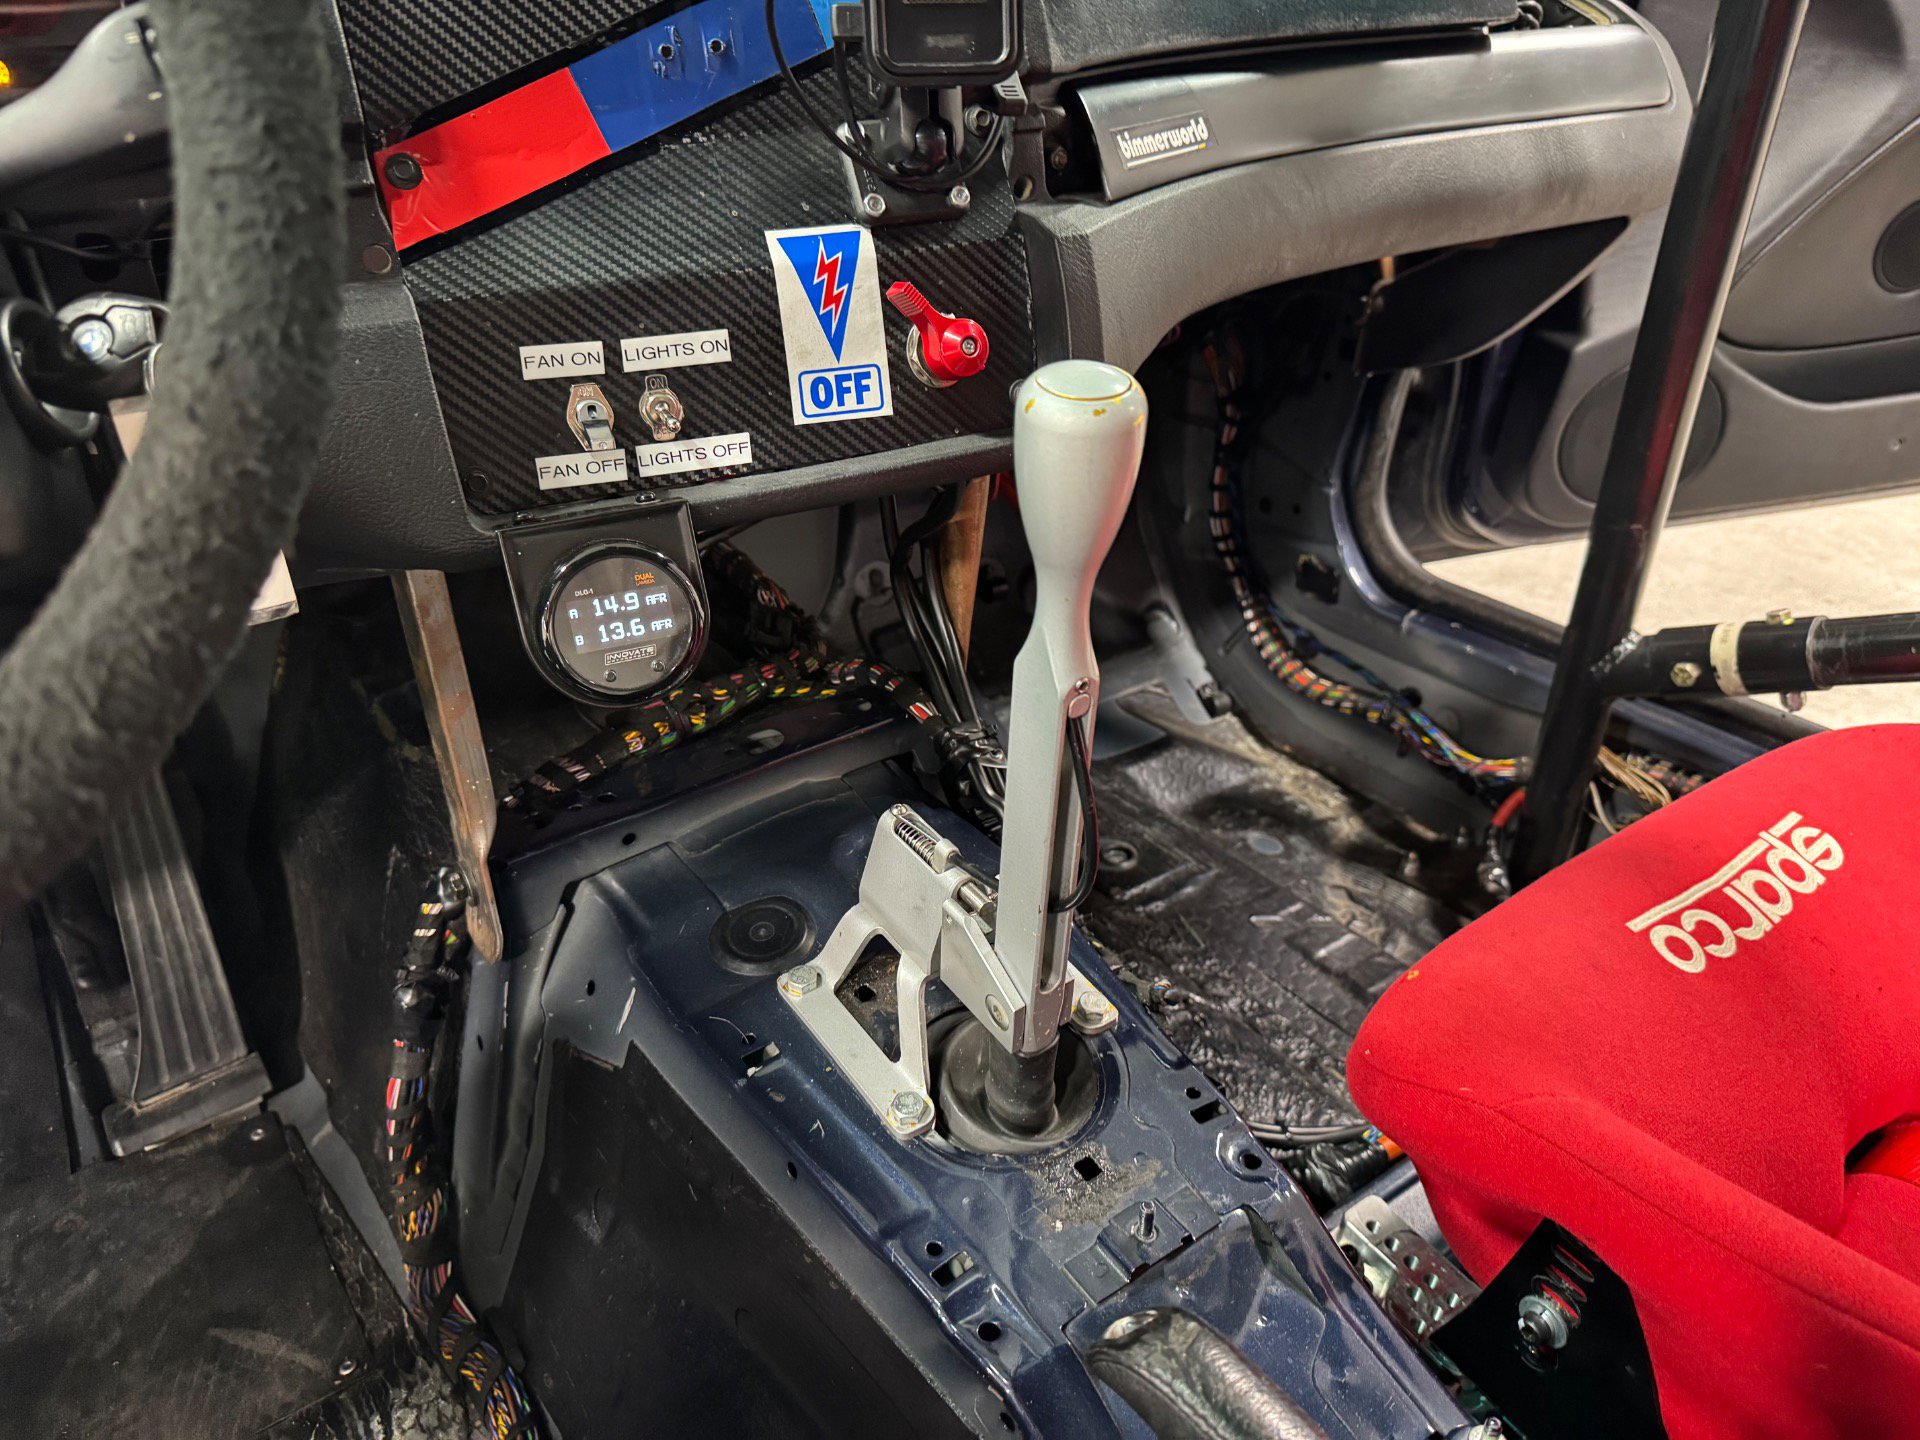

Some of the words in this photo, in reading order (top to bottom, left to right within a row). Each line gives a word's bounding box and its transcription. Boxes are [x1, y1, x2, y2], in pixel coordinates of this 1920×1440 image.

[1117, 117, 1209, 160] bimmerworld
[524, 353, 565, 370] FAN
[571, 351, 601, 366] ON
[624, 342, 695, 362] LIGHTS
[700, 339, 728, 354] ON
[649, 377, 665, 389] ON
[810, 371, 871, 409] OFF
[639, 447, 707, 468] LIGHTS
[712, 441, 749, 457] OFF
[539, 463, 580, 480] FAN
[586, 458, 625, 474] OFF
[634, 572, 654, 581] DUAL
[569, 609, 579, 620] A
[592, 592, 640, 617] 14.9
[645, 592, 668, 606] AFR
[575, 635, 585, 646] B
[598, 618, 646, 643] 13.6
[651, 618, 673, 632] AFR
[606, 646, 654, 661] INNOVATE
[1649, 827, 1845, 974] sparco
